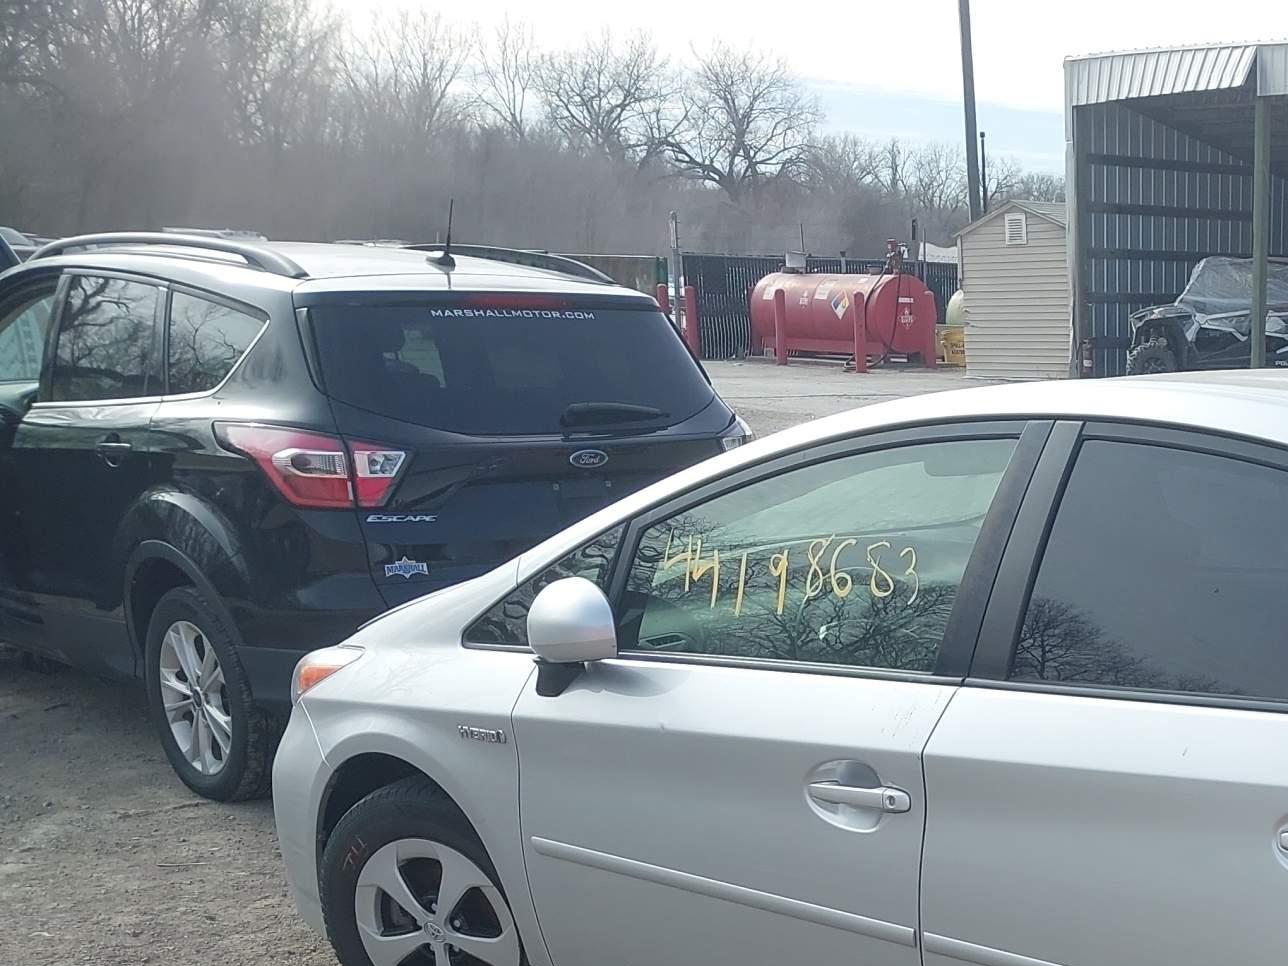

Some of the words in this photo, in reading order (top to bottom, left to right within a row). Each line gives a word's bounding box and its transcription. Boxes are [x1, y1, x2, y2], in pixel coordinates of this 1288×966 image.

[430, 308, 595, 320] MARSHALLMOTOR.COM
[579, 453, 601, 464] Ford
[663, 526, 920, 617] 44198683
